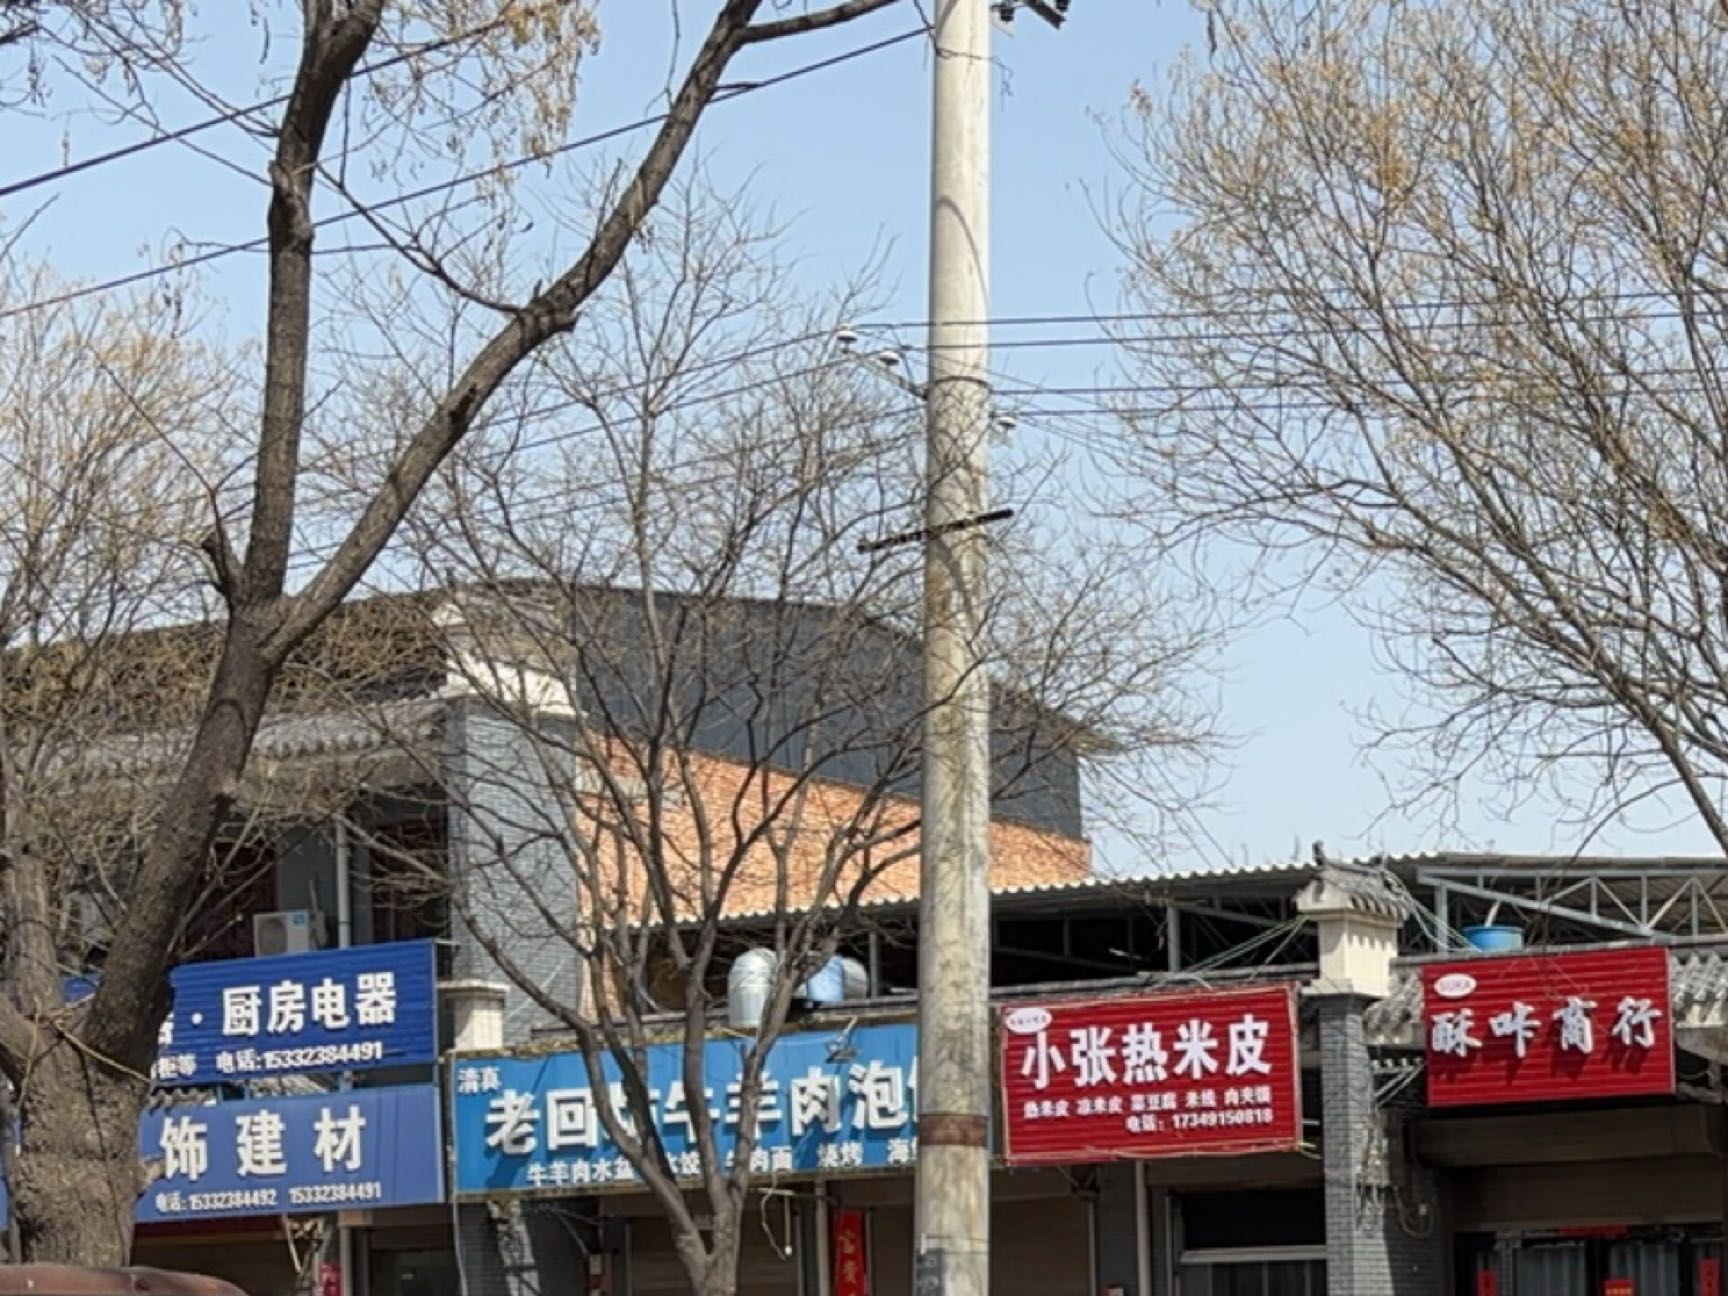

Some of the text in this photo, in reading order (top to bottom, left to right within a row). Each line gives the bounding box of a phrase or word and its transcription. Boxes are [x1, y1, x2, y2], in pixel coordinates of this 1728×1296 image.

[458, 1066, 500, 1094] 清真
[1020, 1013, 1272, 1090] 小张热米皮
[160, 1106, 367, 1181] 饰建材
